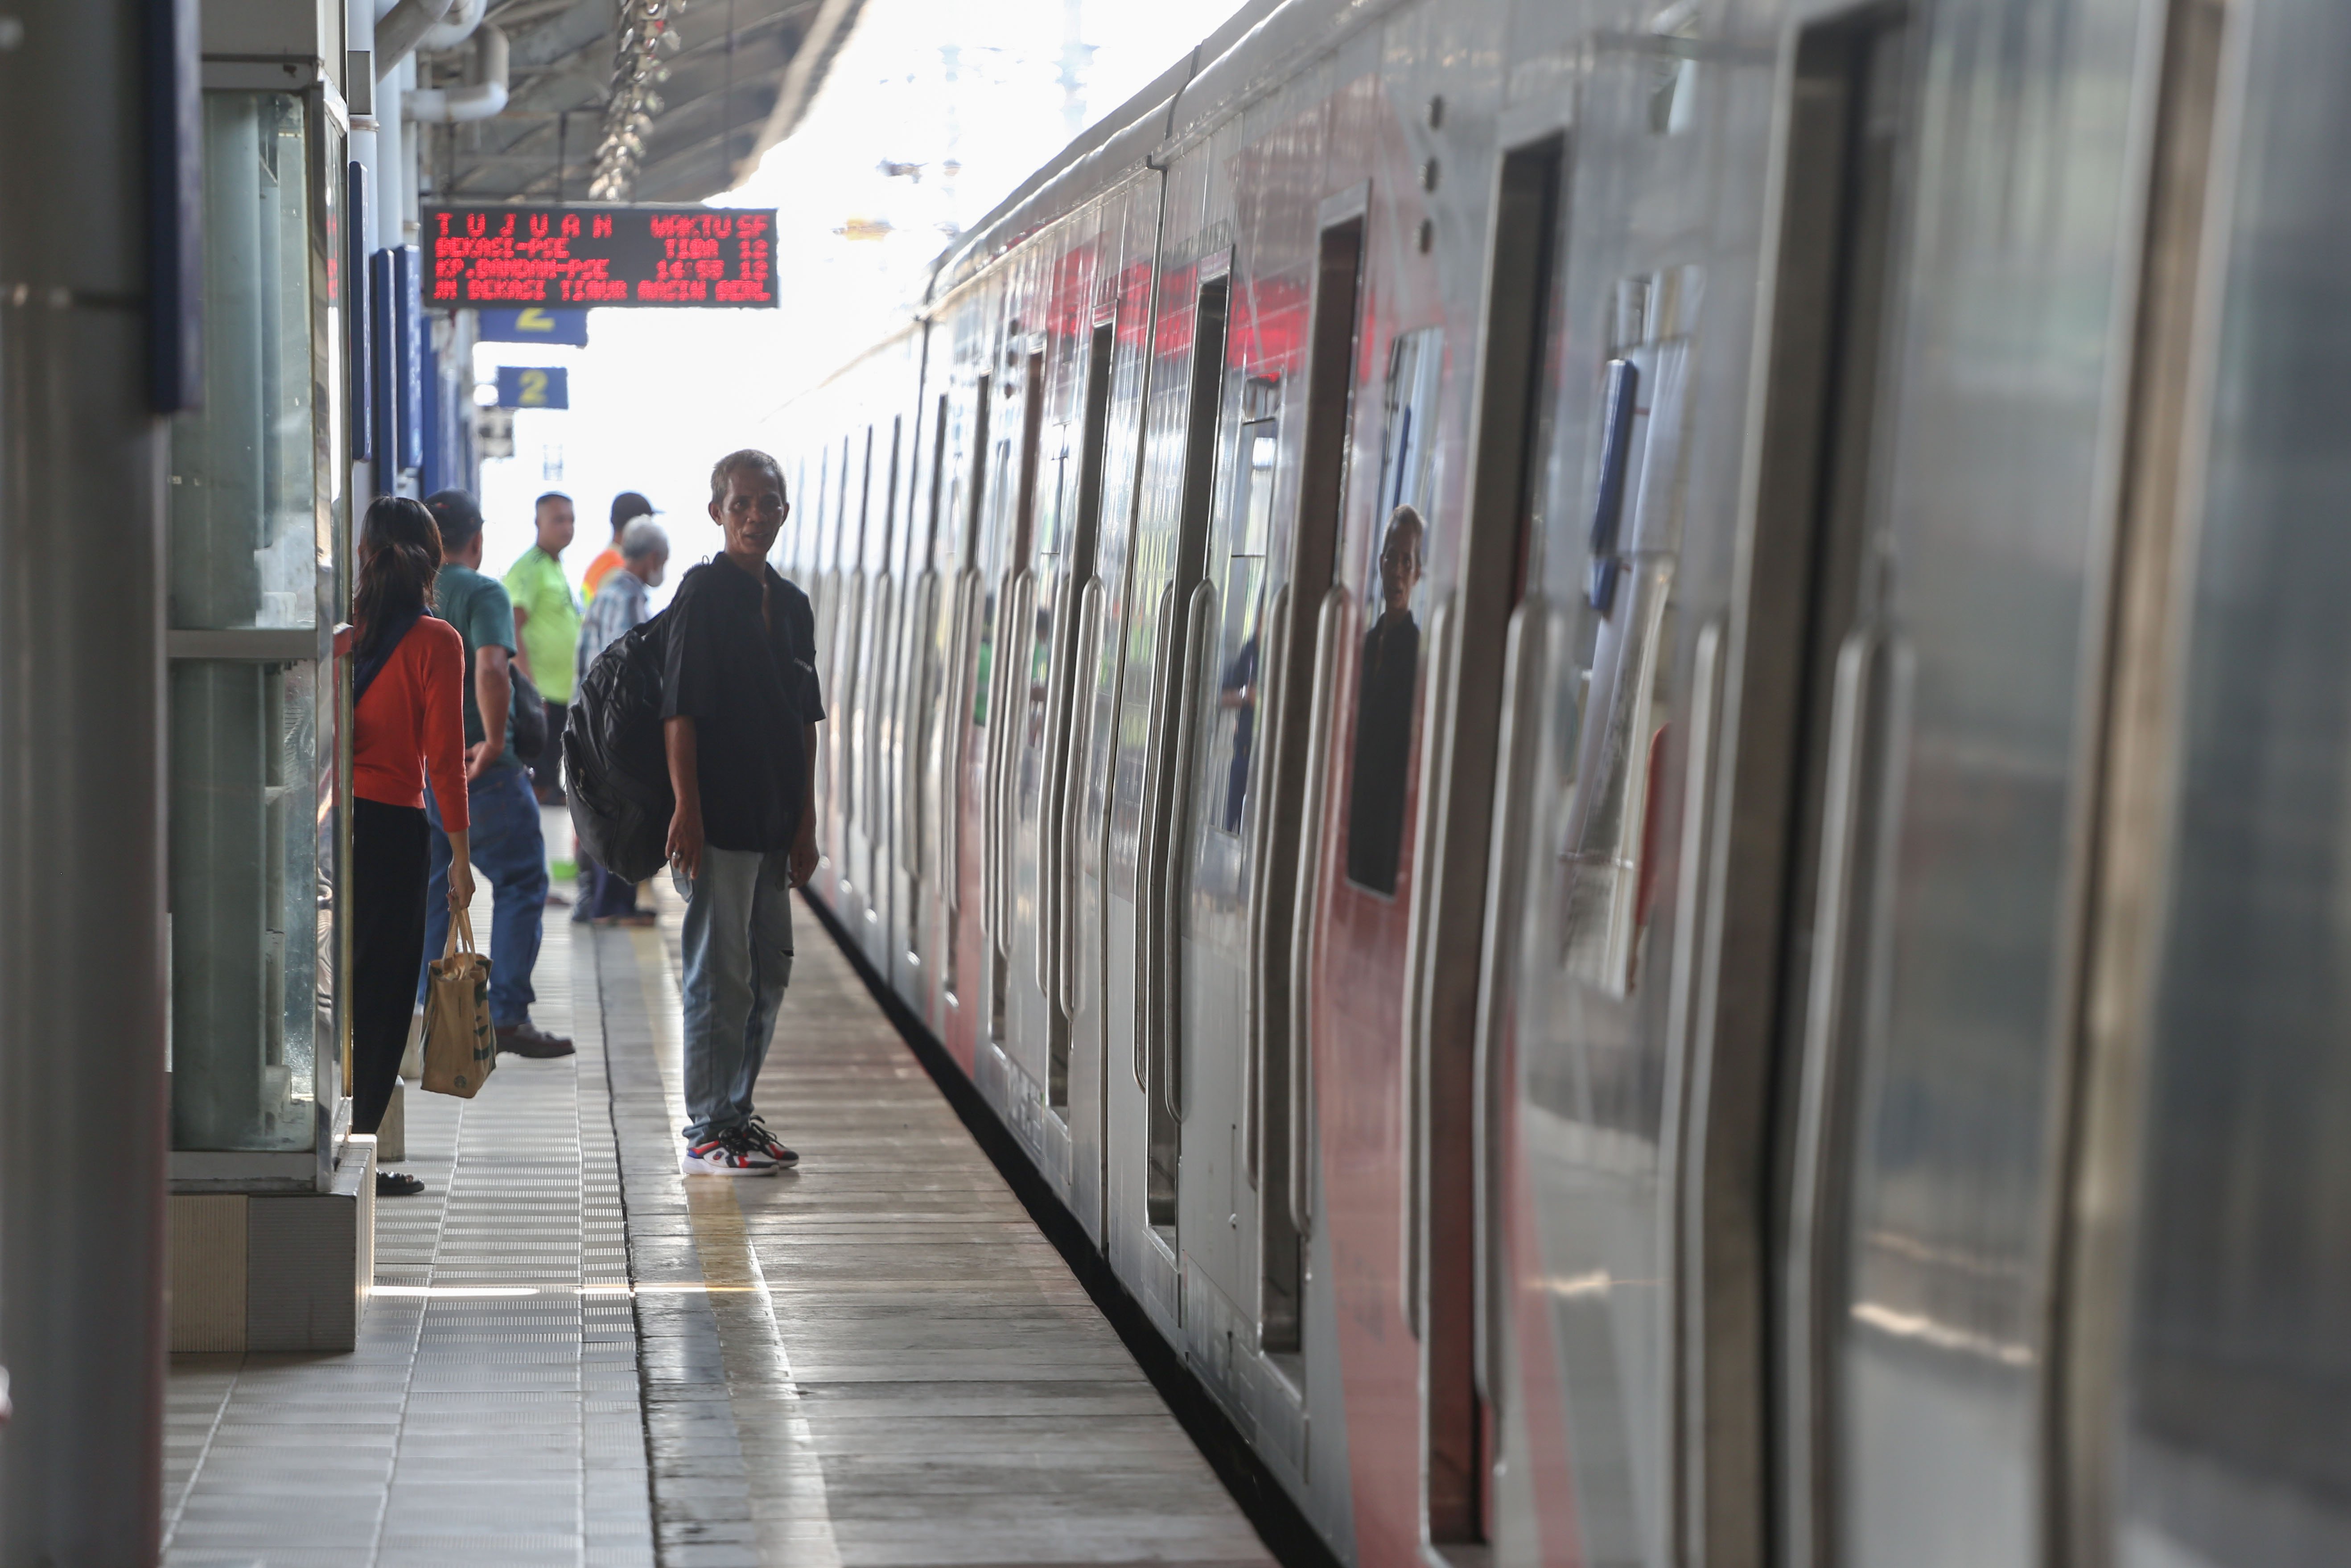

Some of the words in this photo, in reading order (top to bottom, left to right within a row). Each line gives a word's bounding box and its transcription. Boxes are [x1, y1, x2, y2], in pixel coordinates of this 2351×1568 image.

[435, 213, 613, 238] TUJUAN
[650, 214, 732, 238] WAKTU
[519, 369, 548, 406] 2
